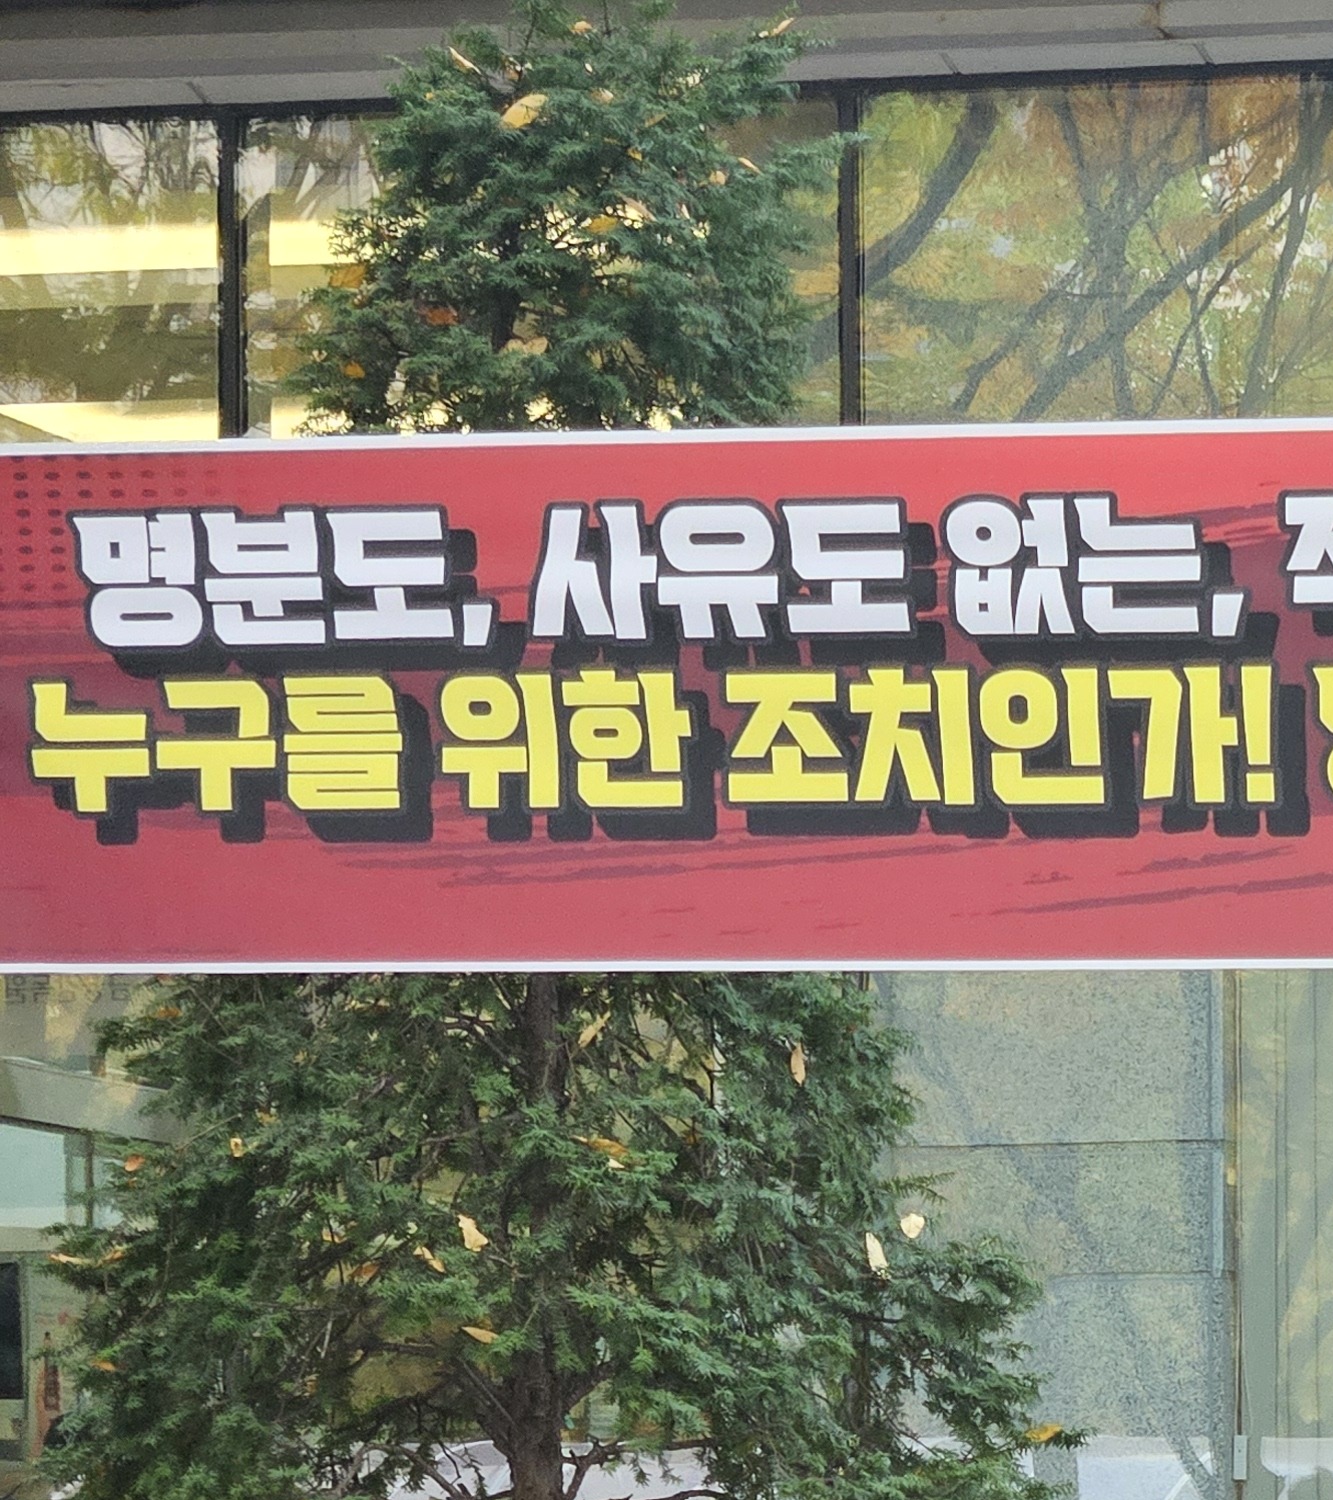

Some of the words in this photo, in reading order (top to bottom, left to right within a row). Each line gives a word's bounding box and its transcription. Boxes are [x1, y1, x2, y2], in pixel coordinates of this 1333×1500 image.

[73, 511, 492, 646] 명분도,
[533, 503, 910, 639] 사유도
[947, 497, 1243, 636] 없는,
[33, 677, 401, 810] 누구를
[443, 670, 689, 806] 위한
[728, 666, 1274, 802] 조치인가!
